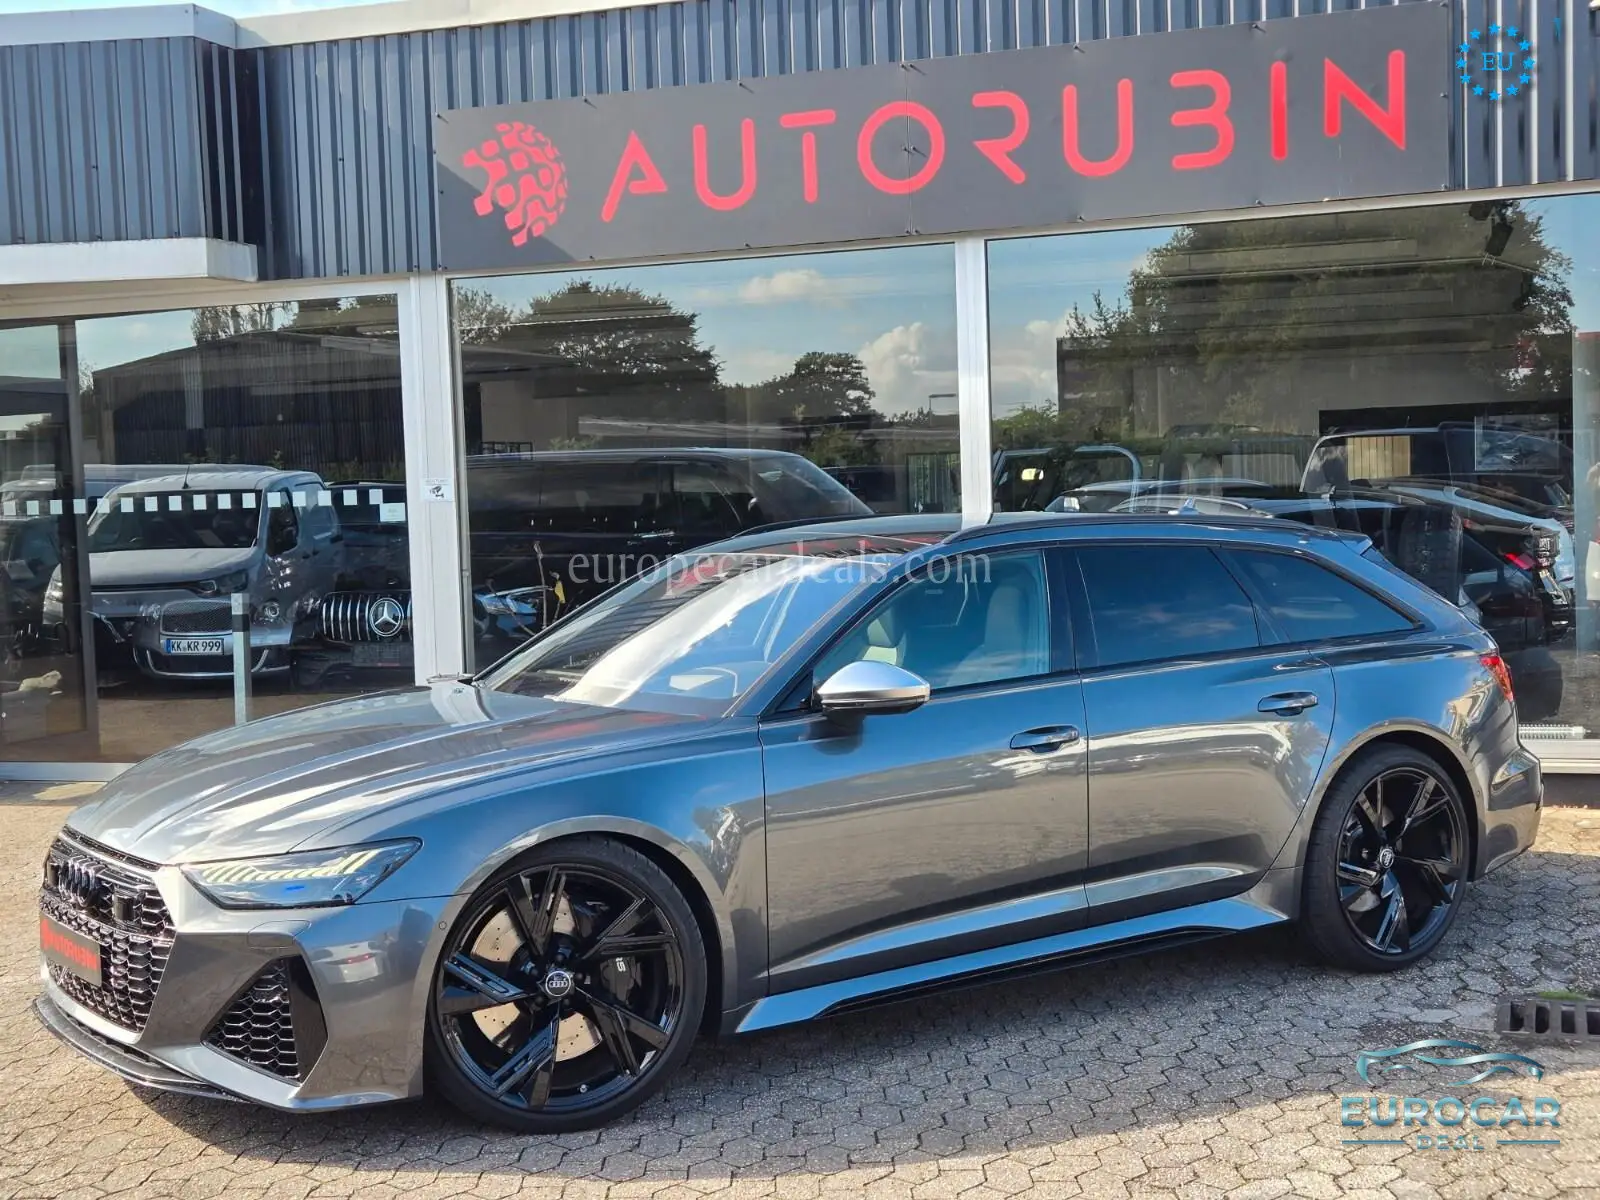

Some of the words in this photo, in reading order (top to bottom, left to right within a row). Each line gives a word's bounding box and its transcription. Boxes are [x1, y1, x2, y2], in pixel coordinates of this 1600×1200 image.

[602, 50, 1406, 222] AUTORUBIN
[171, 641, 182, 651] KK
[187, 641, 200, 652] KR
[201, 641, 221, 652] 999
